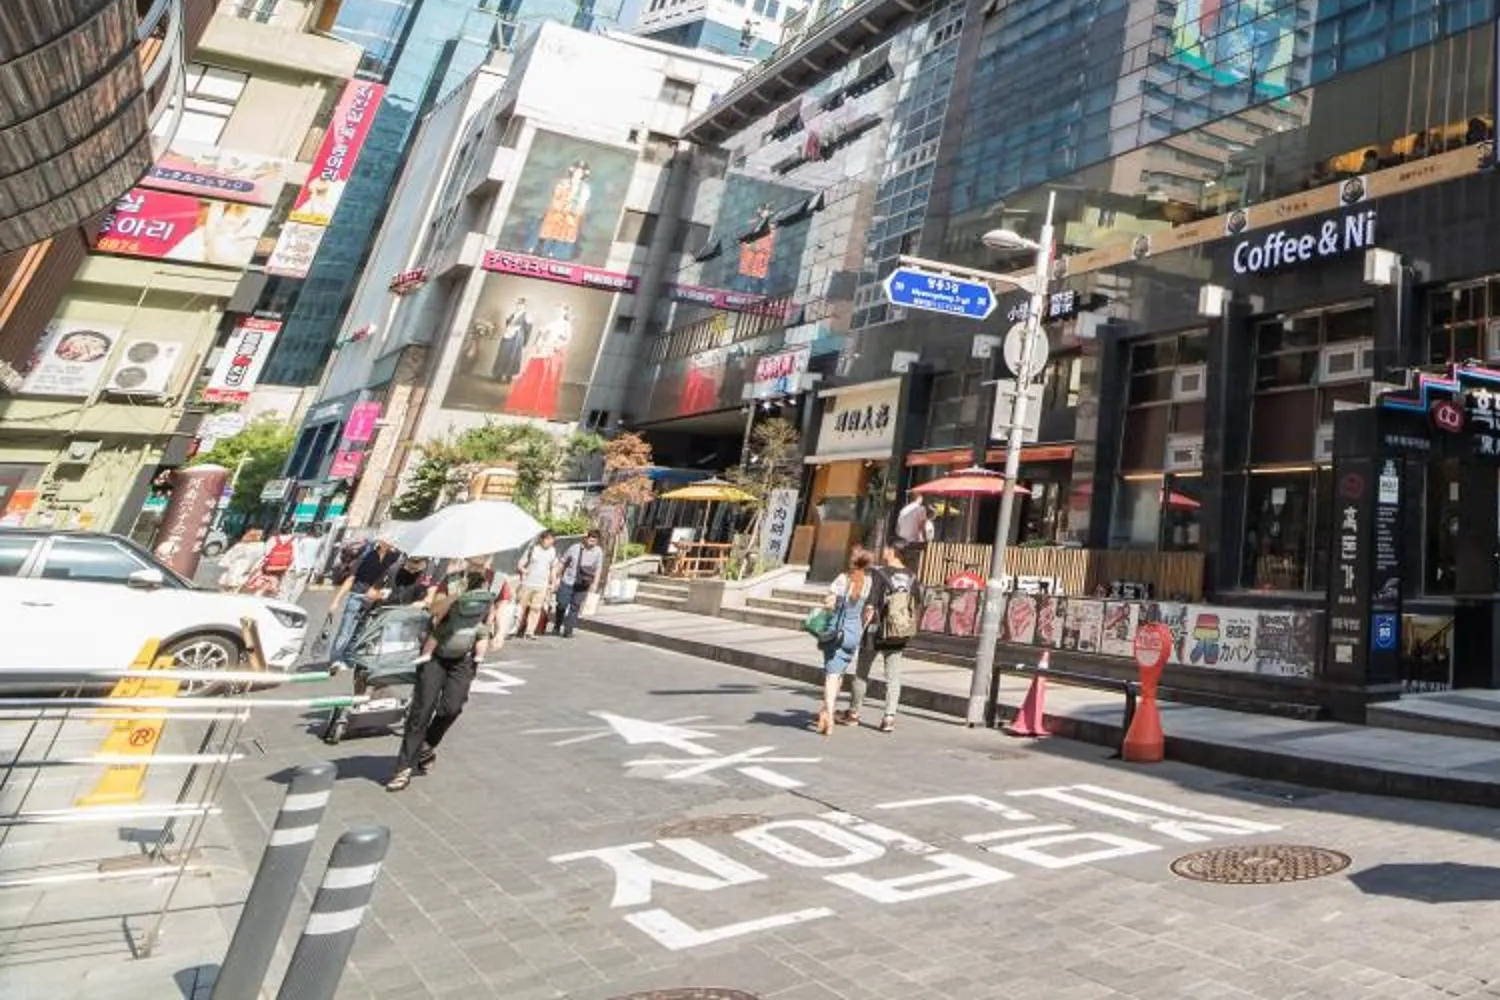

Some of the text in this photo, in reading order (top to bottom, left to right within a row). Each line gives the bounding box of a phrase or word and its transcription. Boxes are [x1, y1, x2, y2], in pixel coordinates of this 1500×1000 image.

[1232, 208, 1378, 274] Coffee & Ni
[1340, 505, 1358, 589] 흑돈가
[547, 783, 1283, 952] 진입금지
